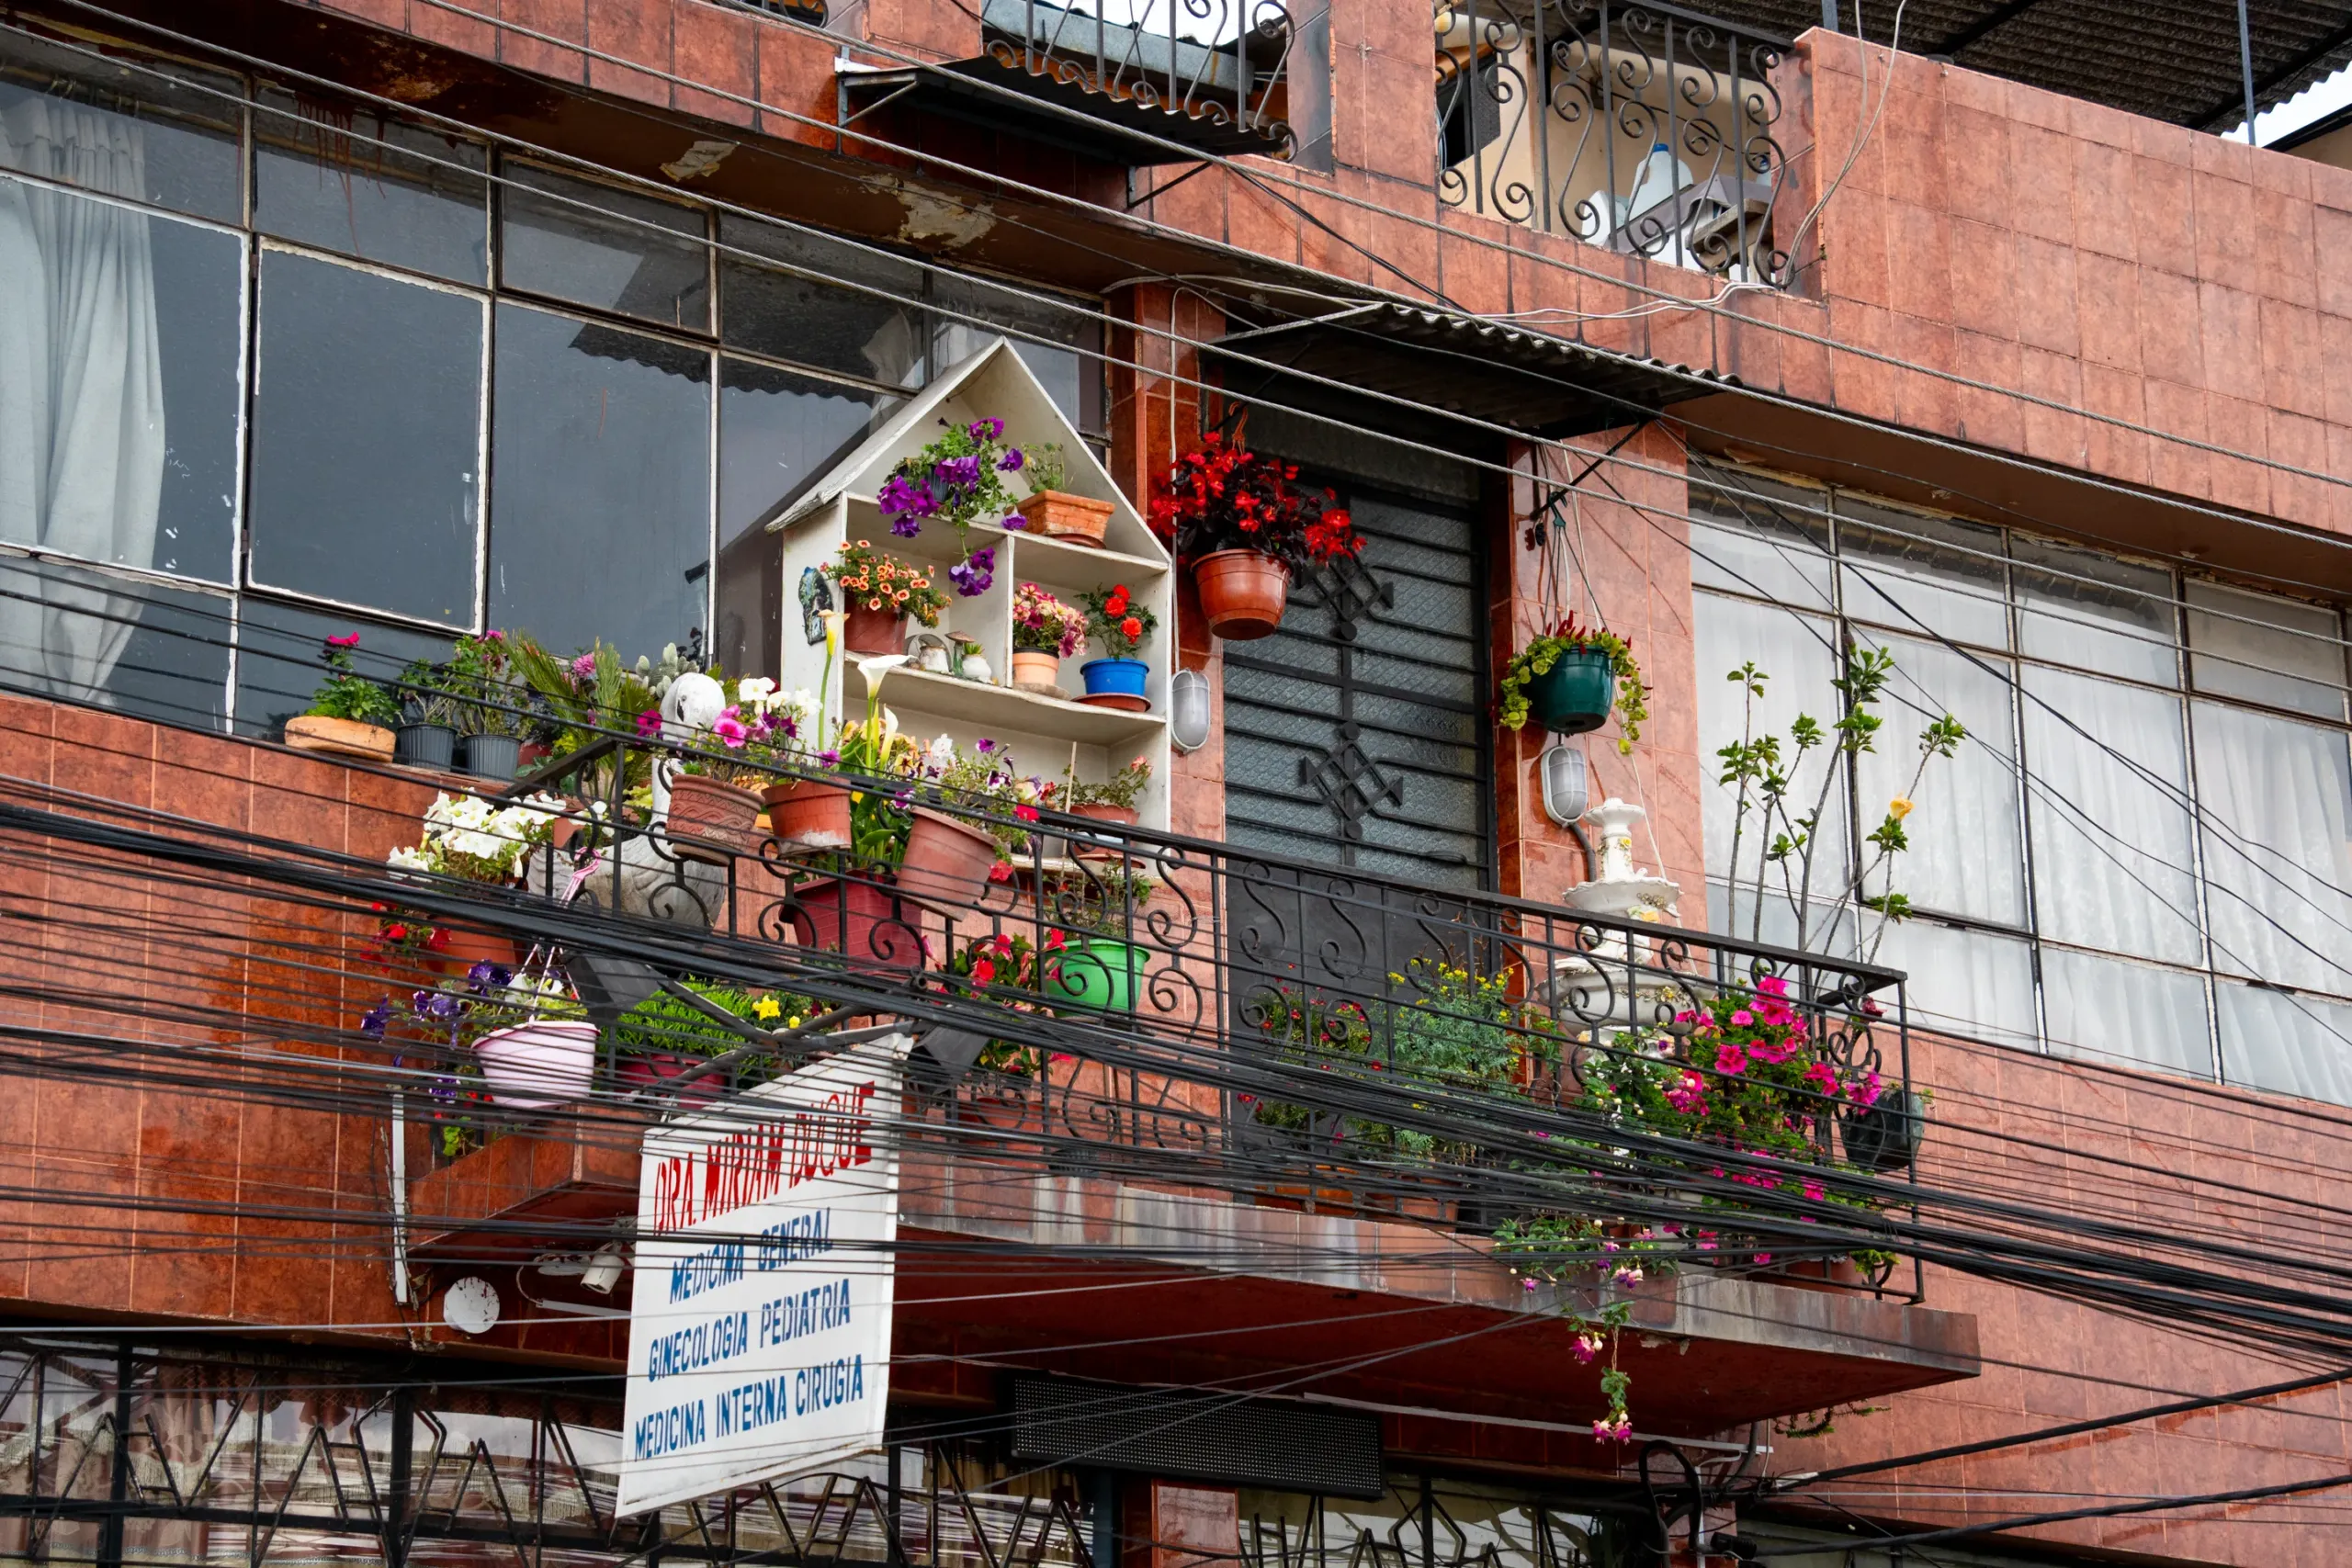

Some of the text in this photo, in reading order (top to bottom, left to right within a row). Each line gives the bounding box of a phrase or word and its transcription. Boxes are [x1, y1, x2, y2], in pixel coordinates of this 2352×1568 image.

[653, 1151, 697, 1236] DRA.
[702, 1114, 786, 1222] MIRIAM
[669, 1206, 833, 1304] MEDICINA GENERAL
[648, 1278, 851, 1382] GINECOLOGIA PEDIATRIA
[635, 1353, 864, 1462] MEDICINA INTERNA CIRUGIA
